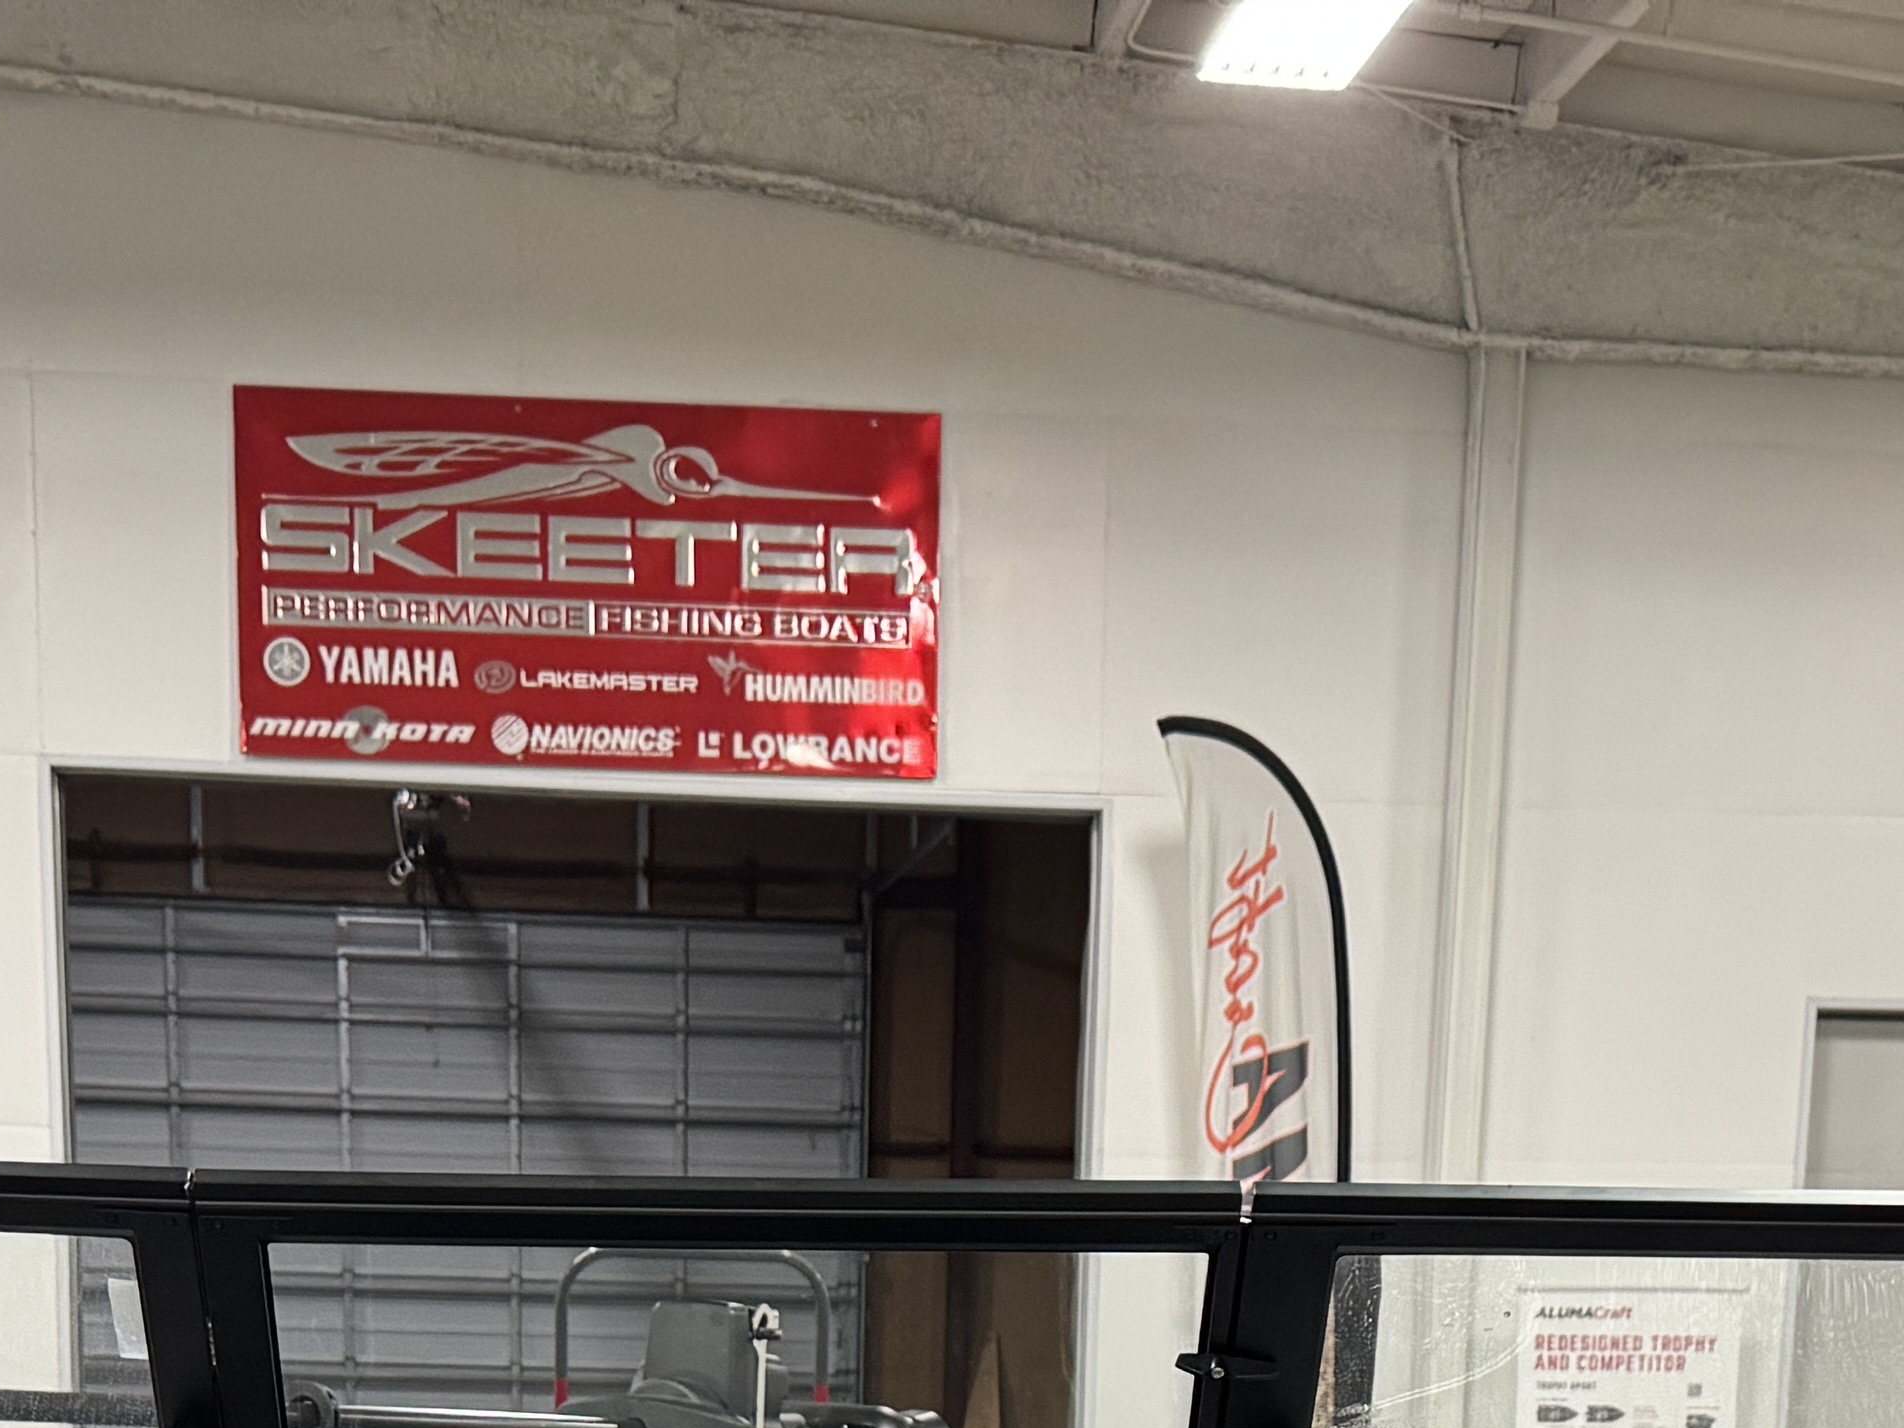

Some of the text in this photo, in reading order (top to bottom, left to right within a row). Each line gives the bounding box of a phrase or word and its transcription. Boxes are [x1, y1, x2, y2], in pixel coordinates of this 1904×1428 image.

[261, 504, 916, 596] SKEETER
[274, 596, 909, 644] PERFORMANCE FISHING BOATS
[318, 645, 459, 688] YAMAHA
[520, 668, 699, 693] LAKEMASTER
[745, 673, 925, 706] HUMMINBIRD
[370, 721, 477, 744] KOTA
[530, 723, 676, 752] NAVIONICS
[733, 731, 923, 765] LOWRANCE
[1534, 1333, 1719, 1354] REDESIGNED TROPHY
[1533, 1353, 1688, 1374] AND COMPETITOR
